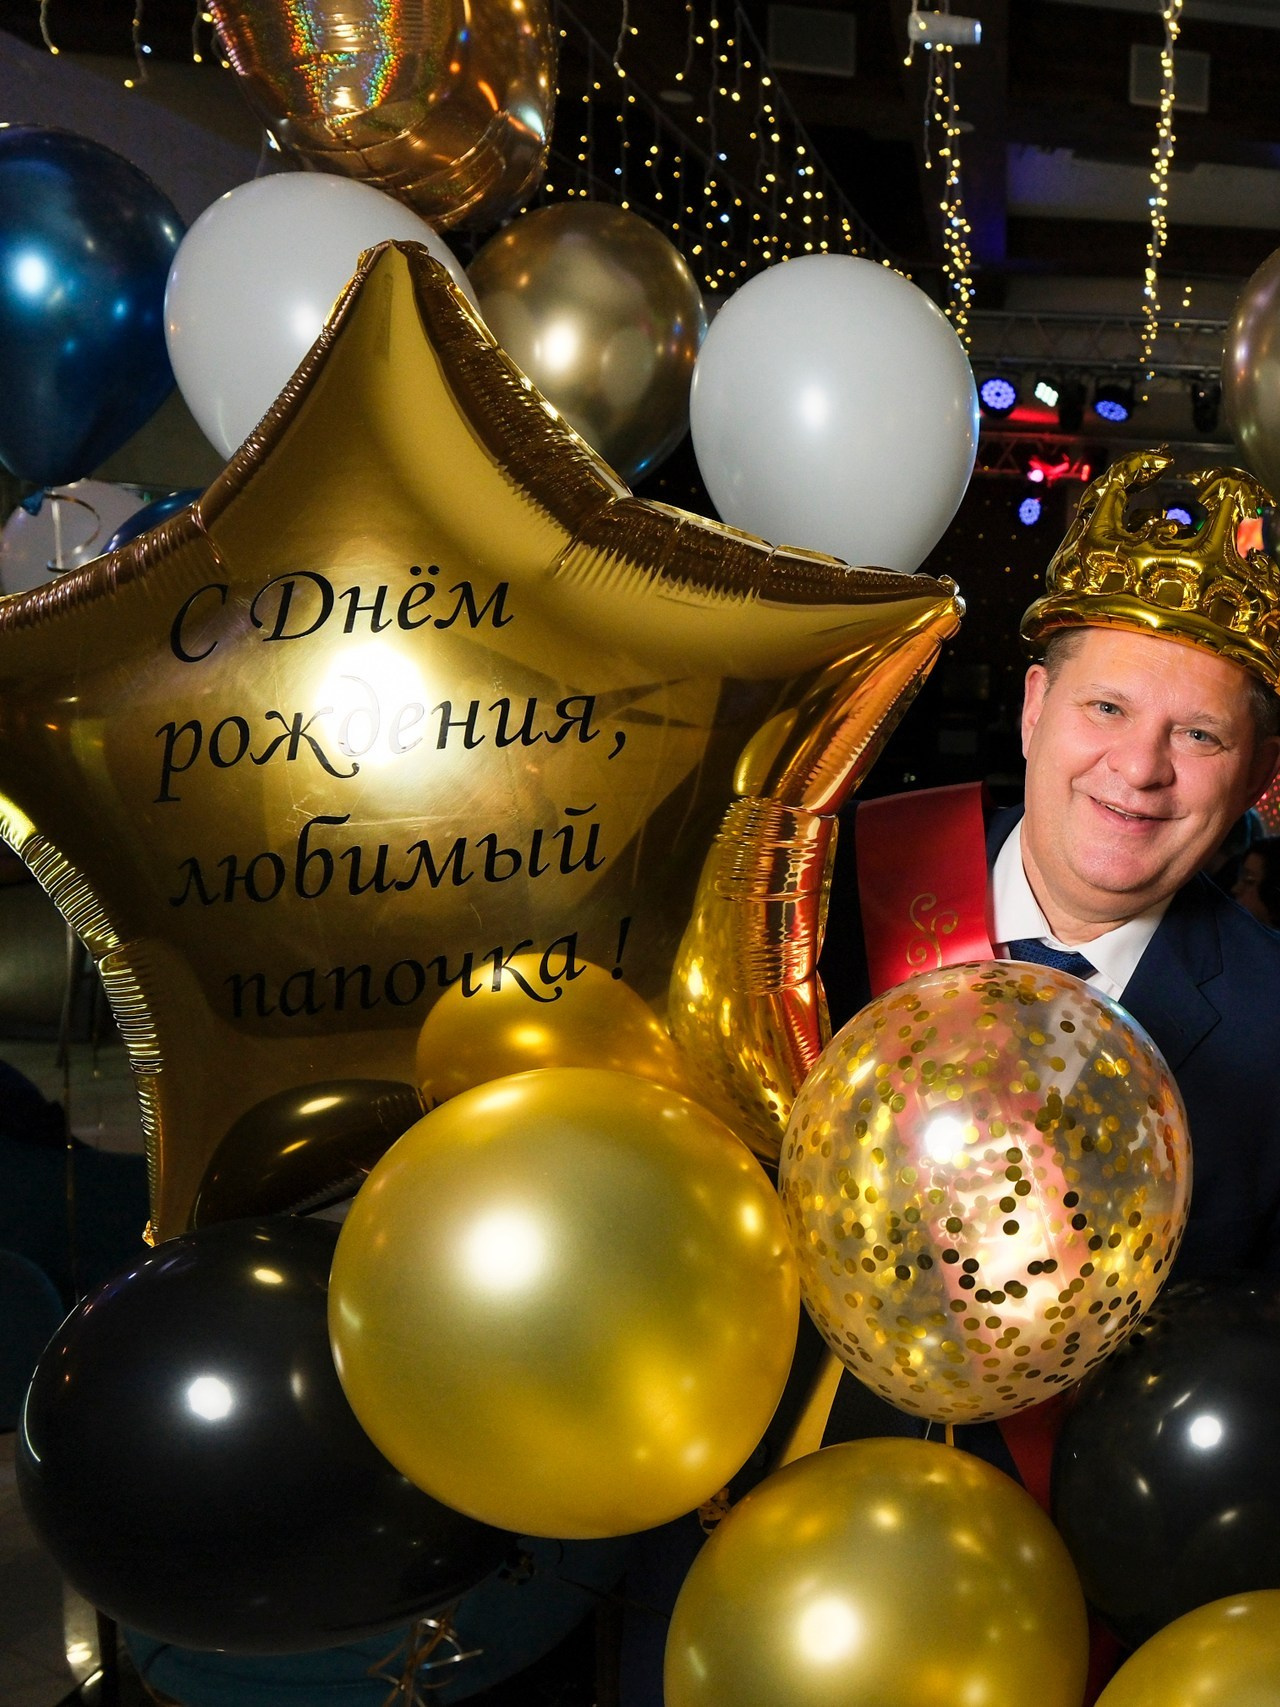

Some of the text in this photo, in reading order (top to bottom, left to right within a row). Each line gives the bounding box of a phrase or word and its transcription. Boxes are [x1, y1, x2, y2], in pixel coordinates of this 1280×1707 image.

[169, 564, 514, 663] С Днём
[153, 674, 628, 803] рождения,
[168, 802, 607, 908] любимый
